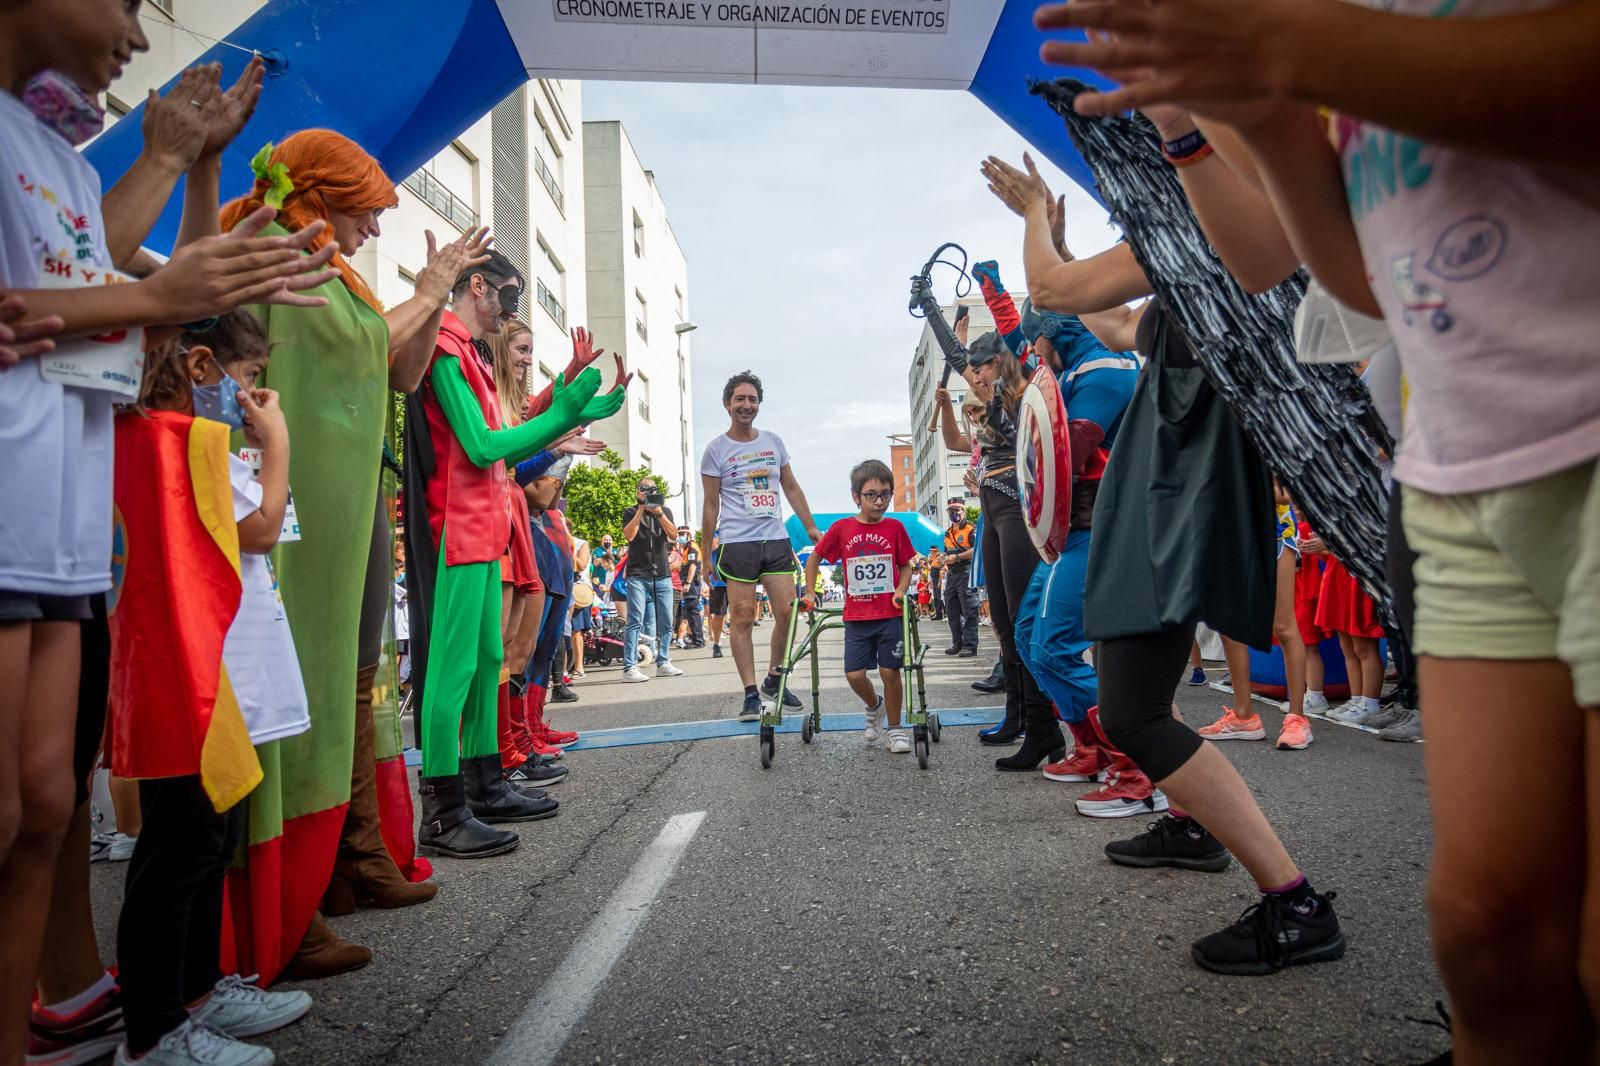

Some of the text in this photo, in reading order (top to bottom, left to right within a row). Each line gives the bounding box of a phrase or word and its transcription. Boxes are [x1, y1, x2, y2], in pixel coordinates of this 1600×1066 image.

[556, 0, 945, 28] CRONOMETRAJE Y ORGANIZACIÓN DE EVENTOS
[751, 494, 775, 507] 383
[845, 533, 892, 551] AHOY MATEY
[854, 563, 887, 581] 632
